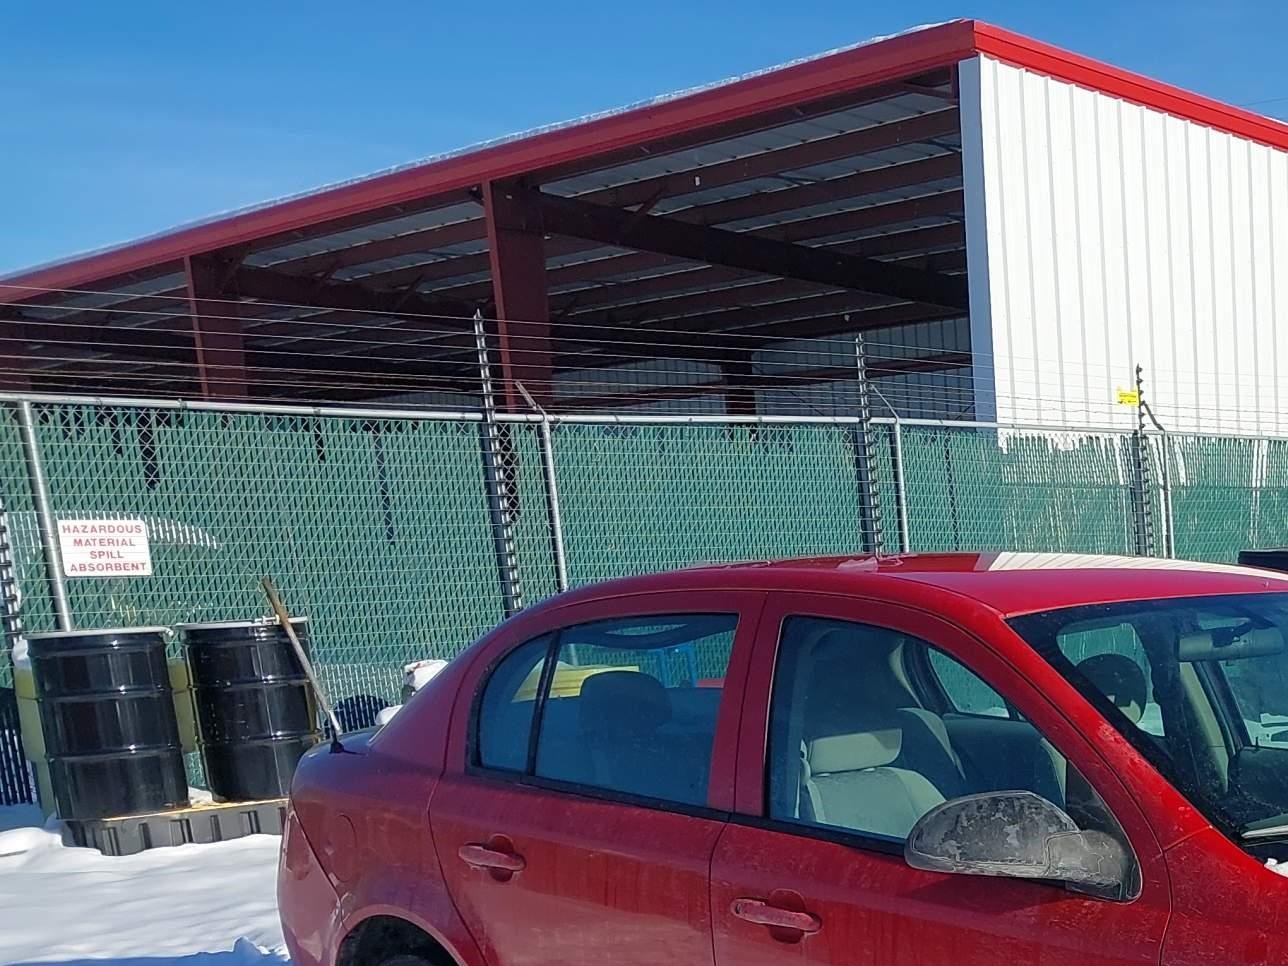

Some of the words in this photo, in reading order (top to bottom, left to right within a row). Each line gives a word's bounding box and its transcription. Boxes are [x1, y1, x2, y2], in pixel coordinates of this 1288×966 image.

[62, 524, 143, 534] HAZARDOUS
[73, 538, 137, 547] MATERIAL
[89, 550, 125, 559] SPILL
[70, 562, 147, 572] ABSORBENT
